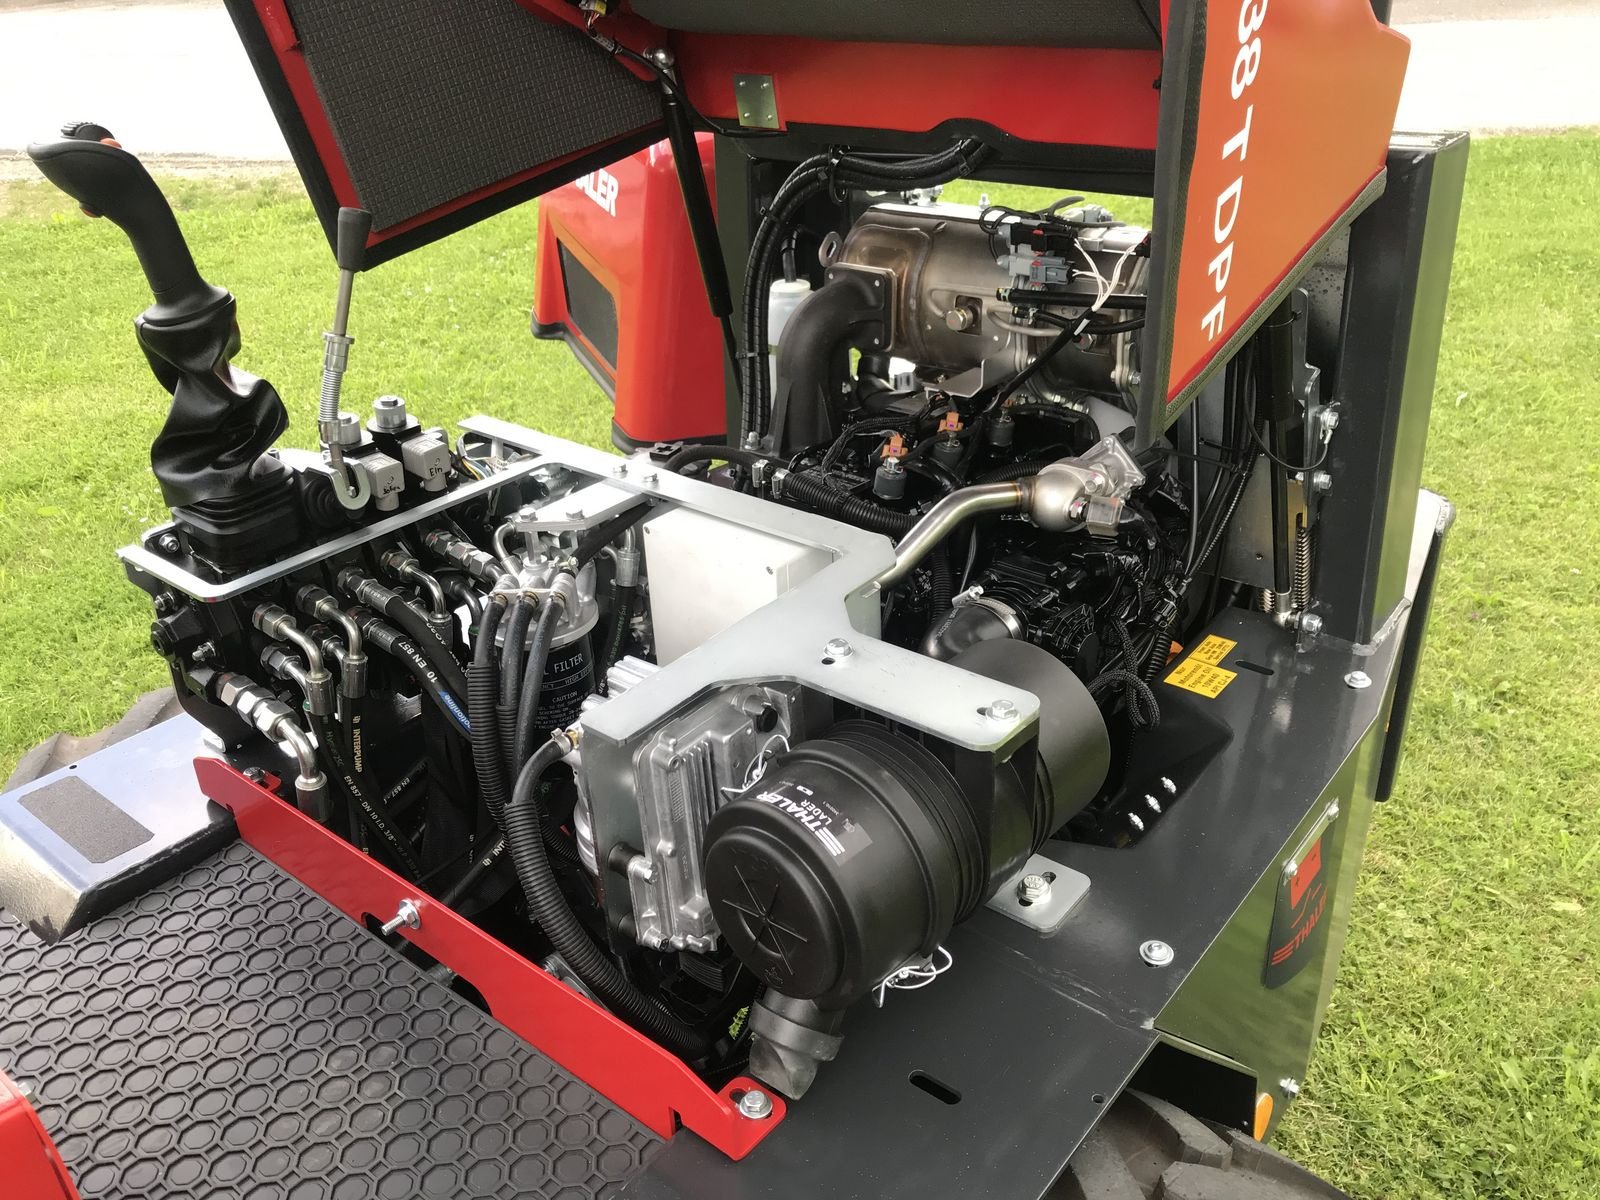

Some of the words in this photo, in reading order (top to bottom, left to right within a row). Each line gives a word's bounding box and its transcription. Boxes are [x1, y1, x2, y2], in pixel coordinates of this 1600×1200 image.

[1200, 175, 1243, 342] DPF
[398, 641, 414, 655] 857
[412, 654, 427, 668] EN
[554, 653, 584, 674] FILTER
[426, 671, 438, 683] 10
[552, 690, 578, 703] CAUTION
[353, 728, 362, 773] INTERPUMP
[344, 775, 354, 786] EN
[350, 786, 362, 796] 857
[362, 802, 372, 812] DN
[370, 812, 378, 820] 10
[756, 790, 822, 832] THALER
[800, 798, 833, 825] LADER
